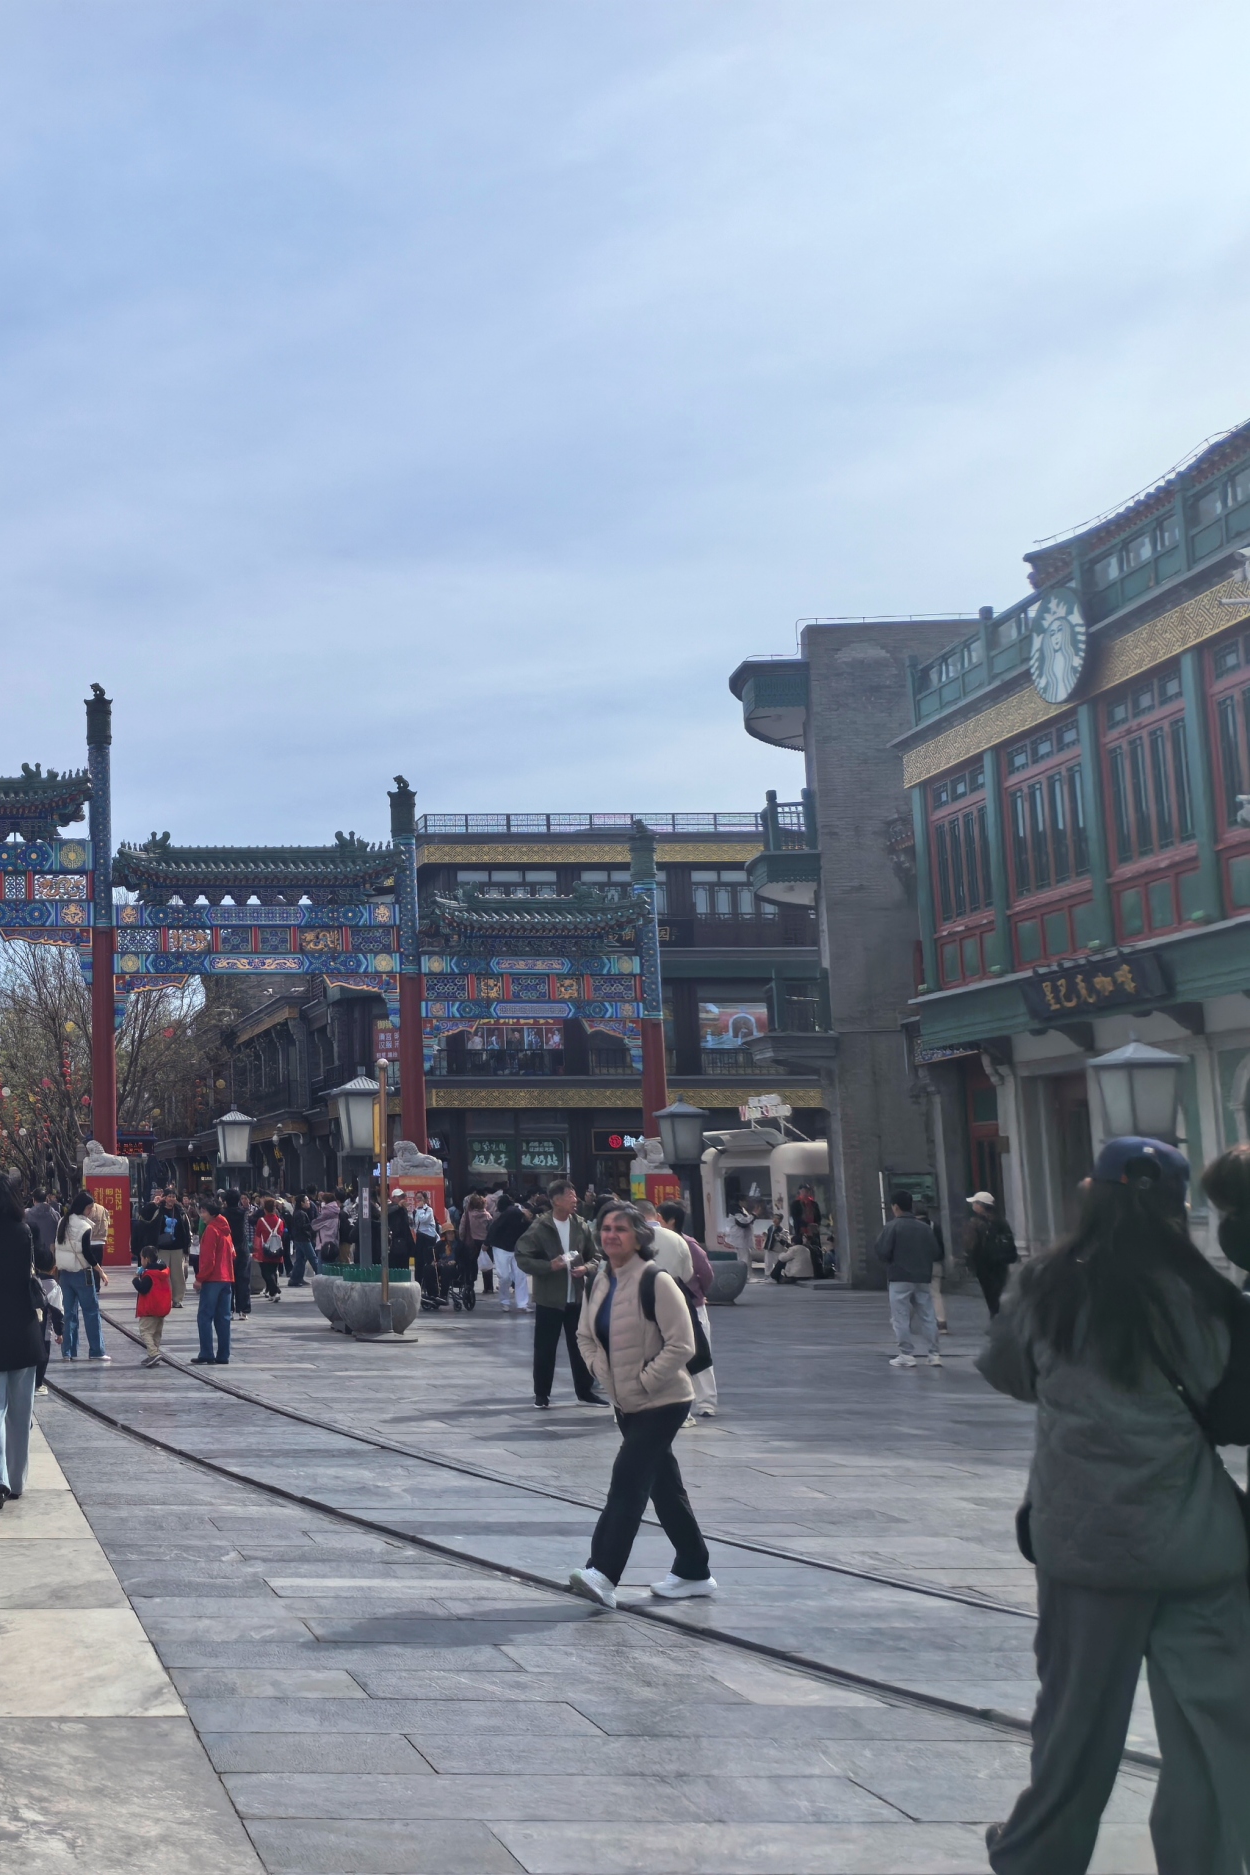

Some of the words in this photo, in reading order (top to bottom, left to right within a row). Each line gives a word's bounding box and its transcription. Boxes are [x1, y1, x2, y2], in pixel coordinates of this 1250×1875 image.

[1042, 964, 1137, 1010] 星巴克咖啡
